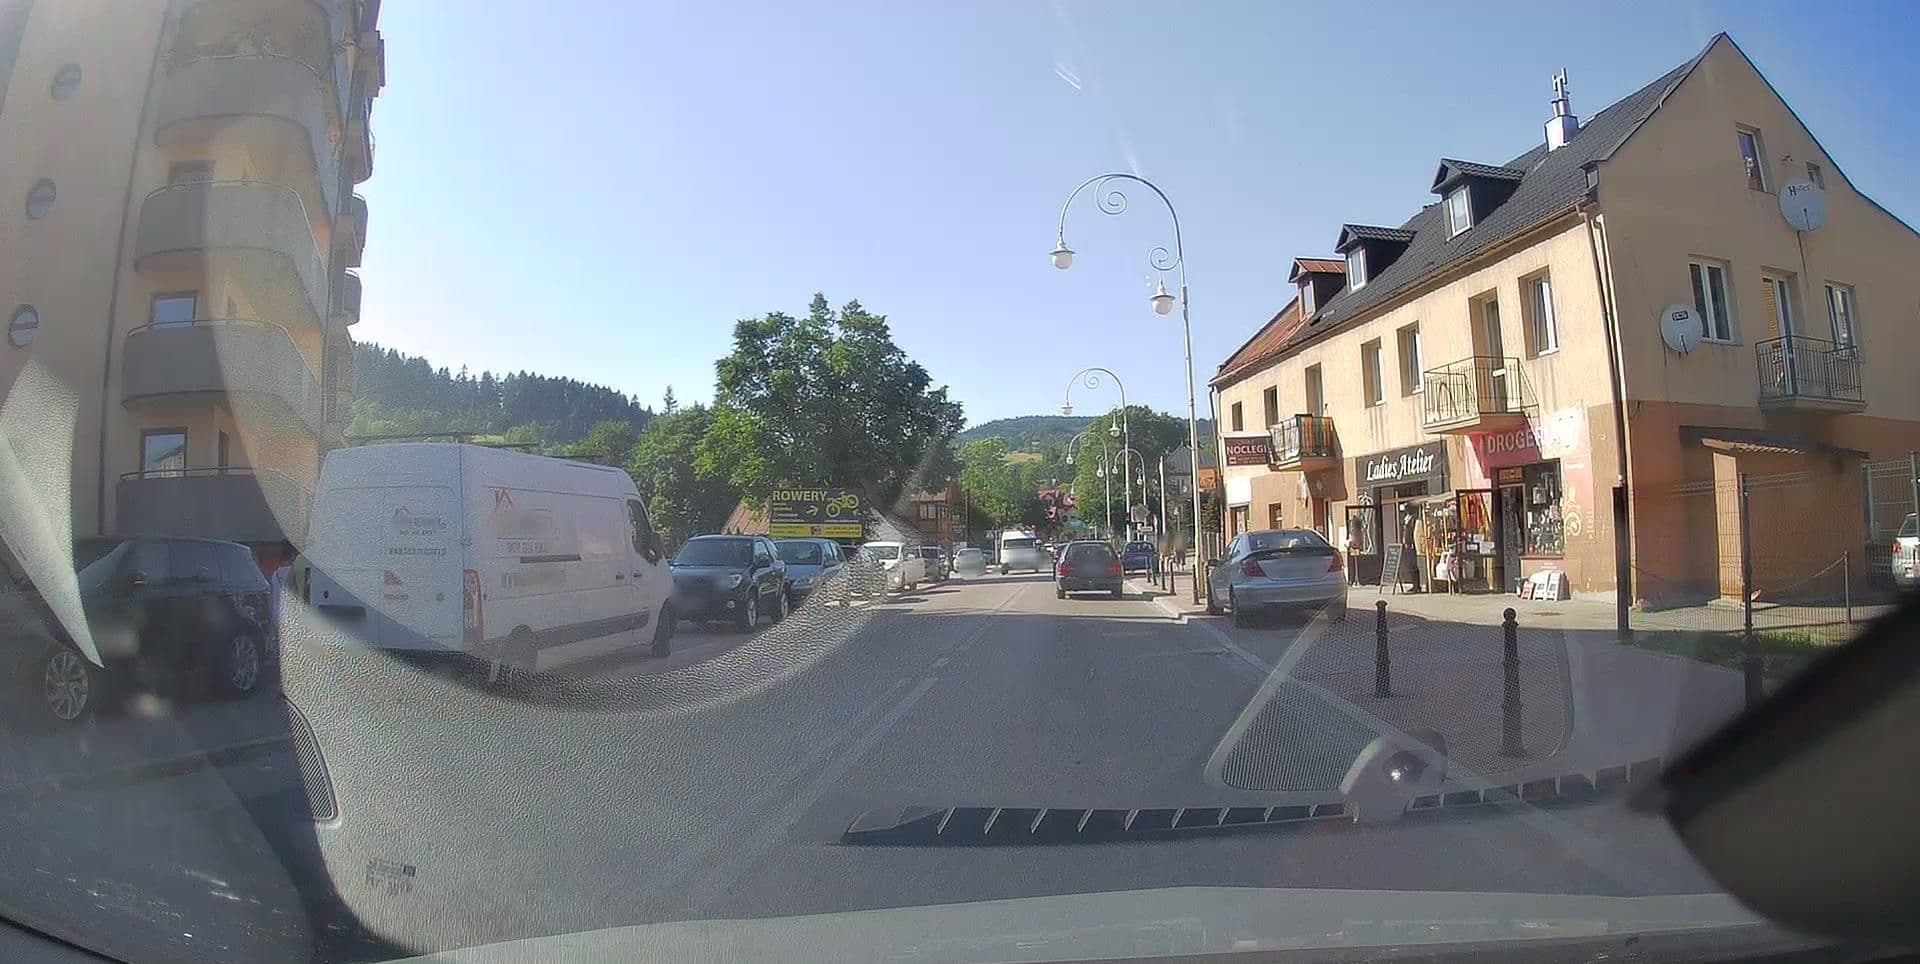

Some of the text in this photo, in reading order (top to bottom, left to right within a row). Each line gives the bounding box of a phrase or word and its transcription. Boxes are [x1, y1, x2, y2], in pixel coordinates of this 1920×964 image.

[1226, 444, 1267, 455] NOCLEGI
[1487, 427, 1540, 454] DROGE
[1366, 449, 1434, 481] Ladies Atelier
[772, 490, 827, 501] ROWERY
